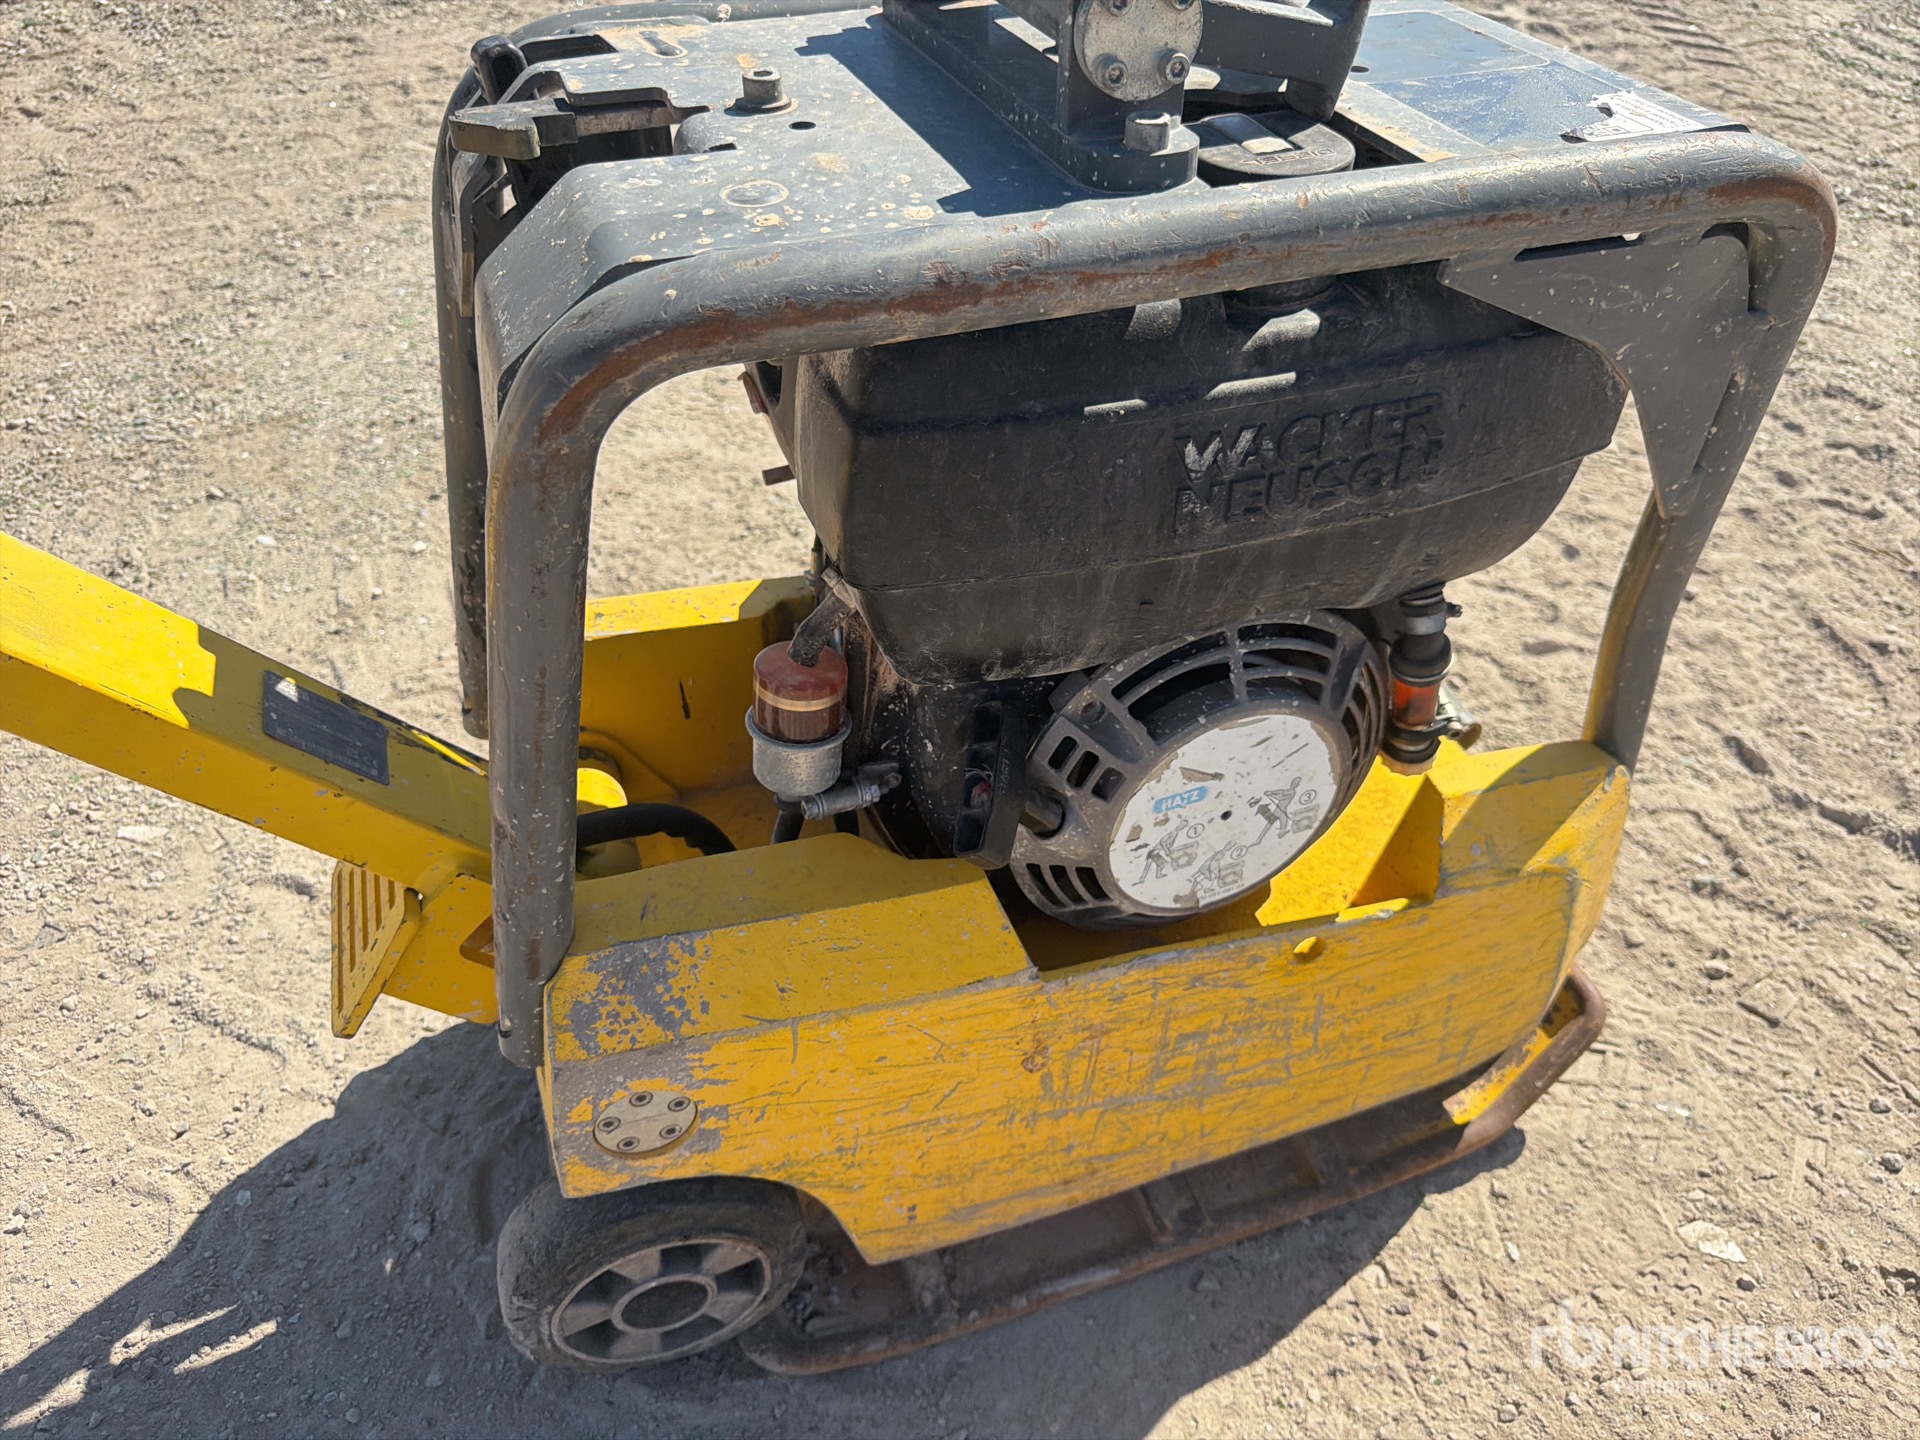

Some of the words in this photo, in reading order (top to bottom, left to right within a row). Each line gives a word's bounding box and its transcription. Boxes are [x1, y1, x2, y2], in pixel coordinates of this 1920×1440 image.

[1243, 147, 1335, 166] DIESEL
[1174, 392, 1444, 480] WACKER
[1162, 790, 1201, 811] HATZ
